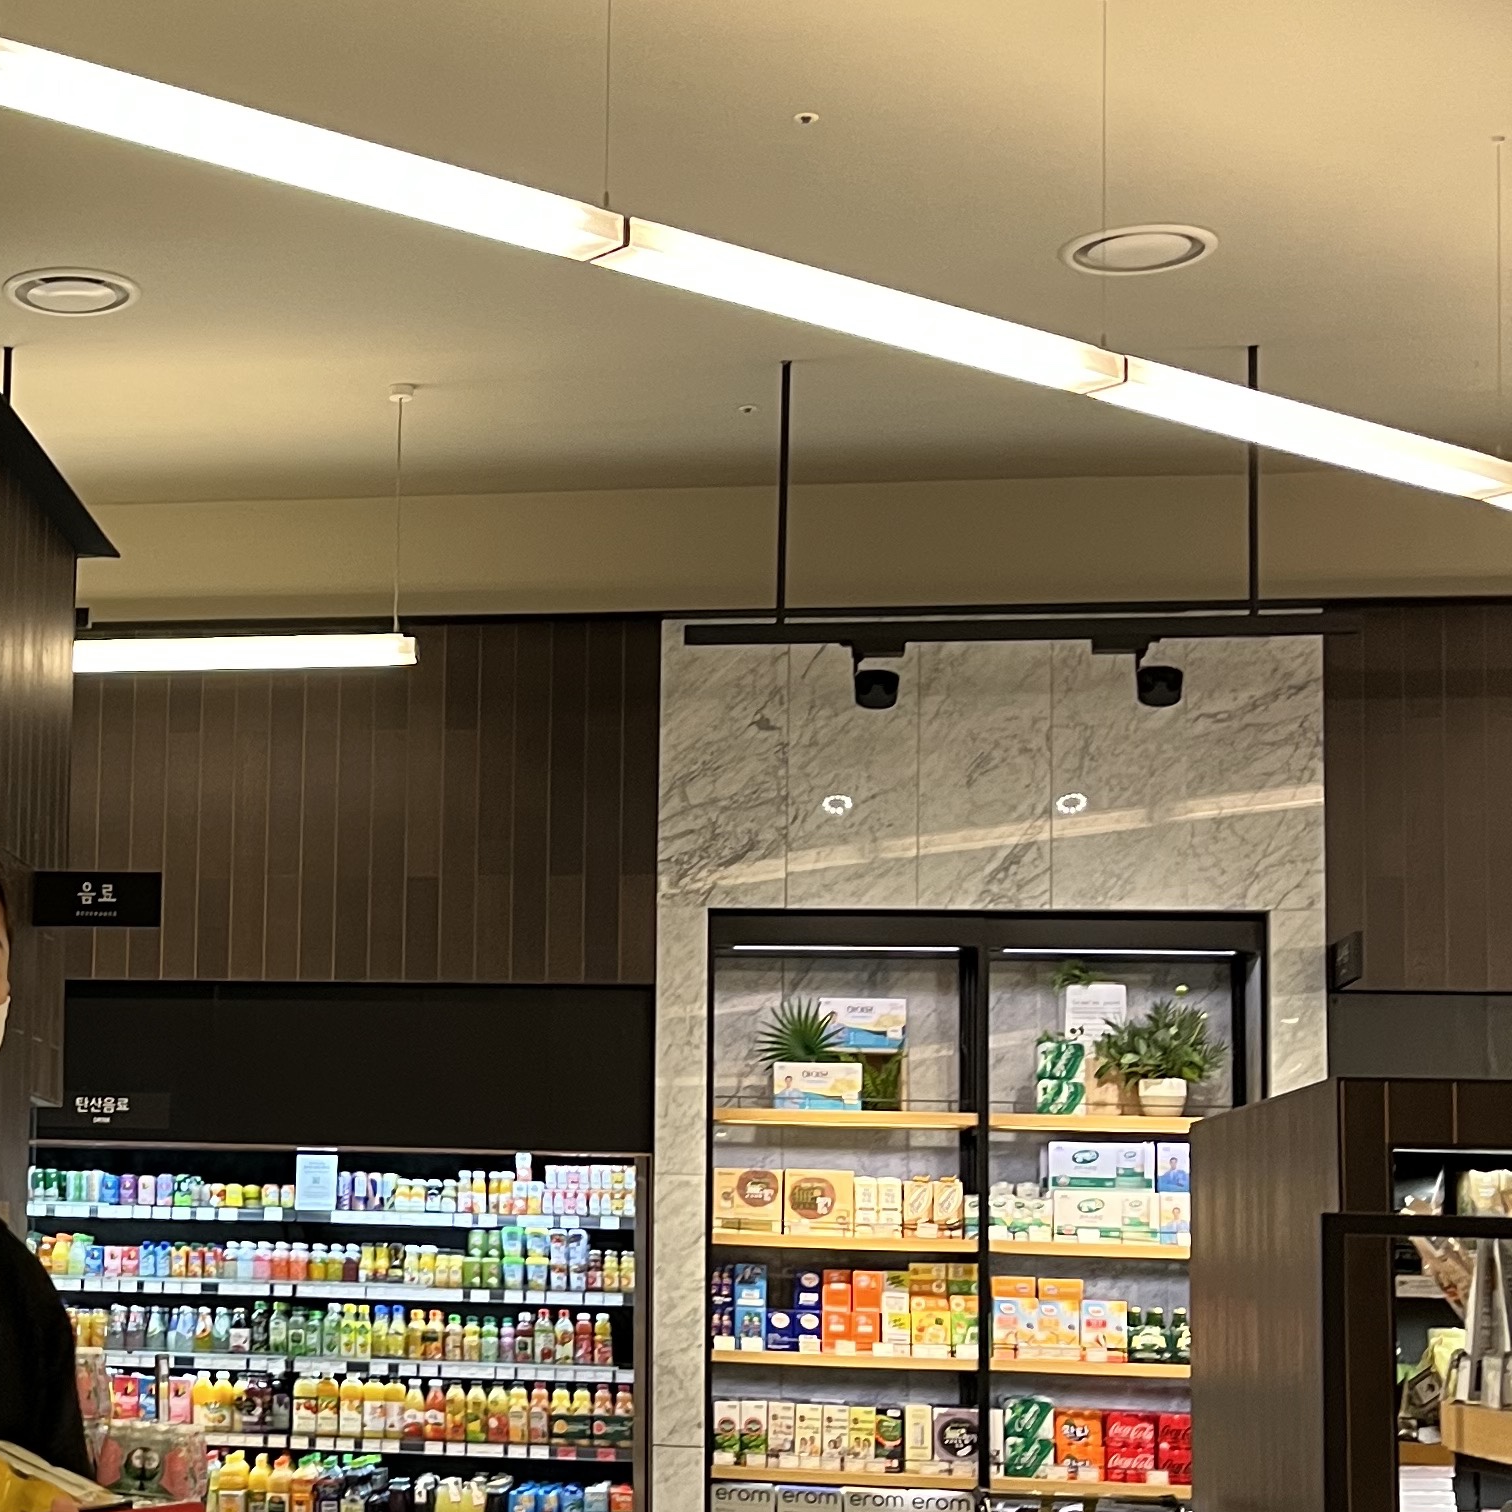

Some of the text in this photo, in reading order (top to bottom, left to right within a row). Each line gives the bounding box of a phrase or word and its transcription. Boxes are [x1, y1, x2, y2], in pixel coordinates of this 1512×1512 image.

[76, 881, 117, 905] 음료
[75, 1096, 130, 1114] 탄산음료
[715, 1487, 771, 1504] erom
[782, 1489, 839, 1506] erom
[849, 1492, 905, 1509] erom
[911, 1495, 972, 1512] erom
